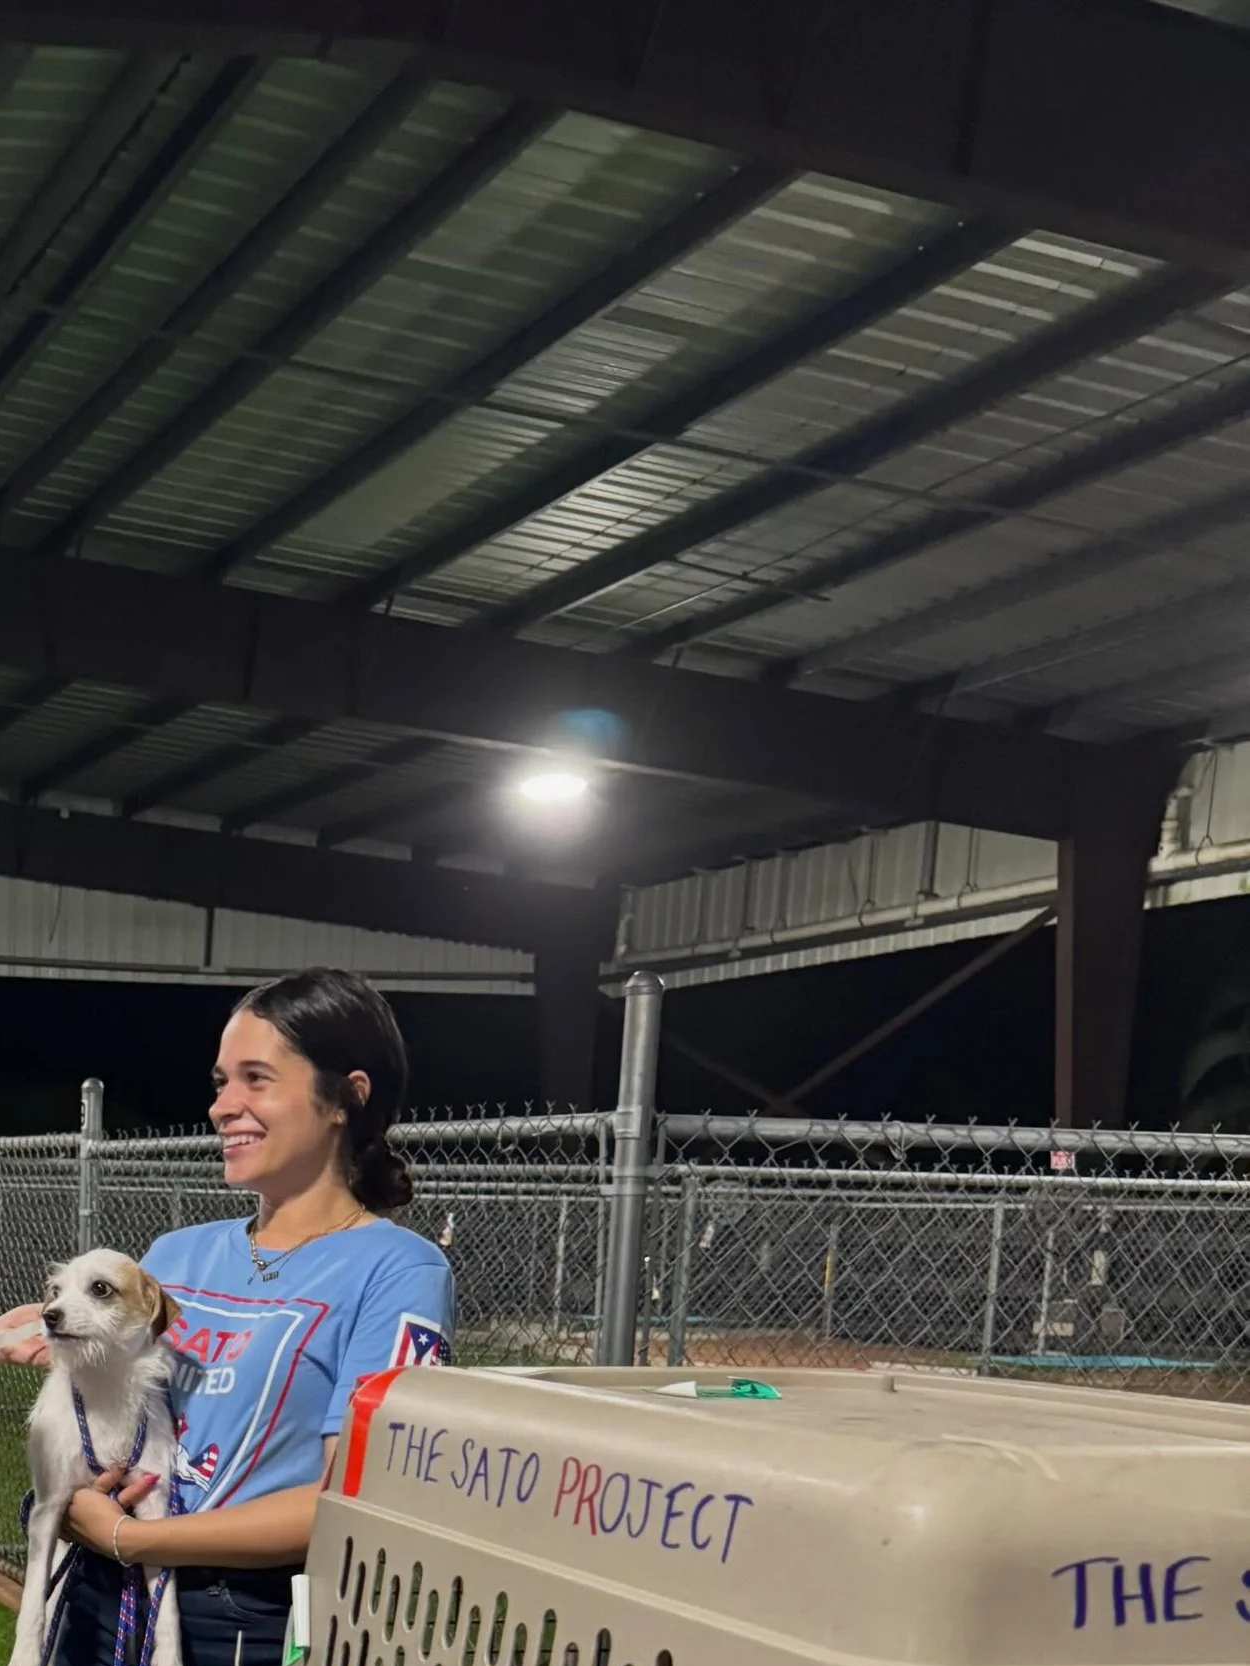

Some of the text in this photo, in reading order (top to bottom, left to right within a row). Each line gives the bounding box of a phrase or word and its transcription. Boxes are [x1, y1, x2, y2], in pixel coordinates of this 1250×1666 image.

[166, 1315, 253, 1364] SATO
[176, 1364, 236, 1395] ITED
[386, 1422, 755, 1564] THE SATO PROJECT
[1051, 1556, 1212, 1630] THE
